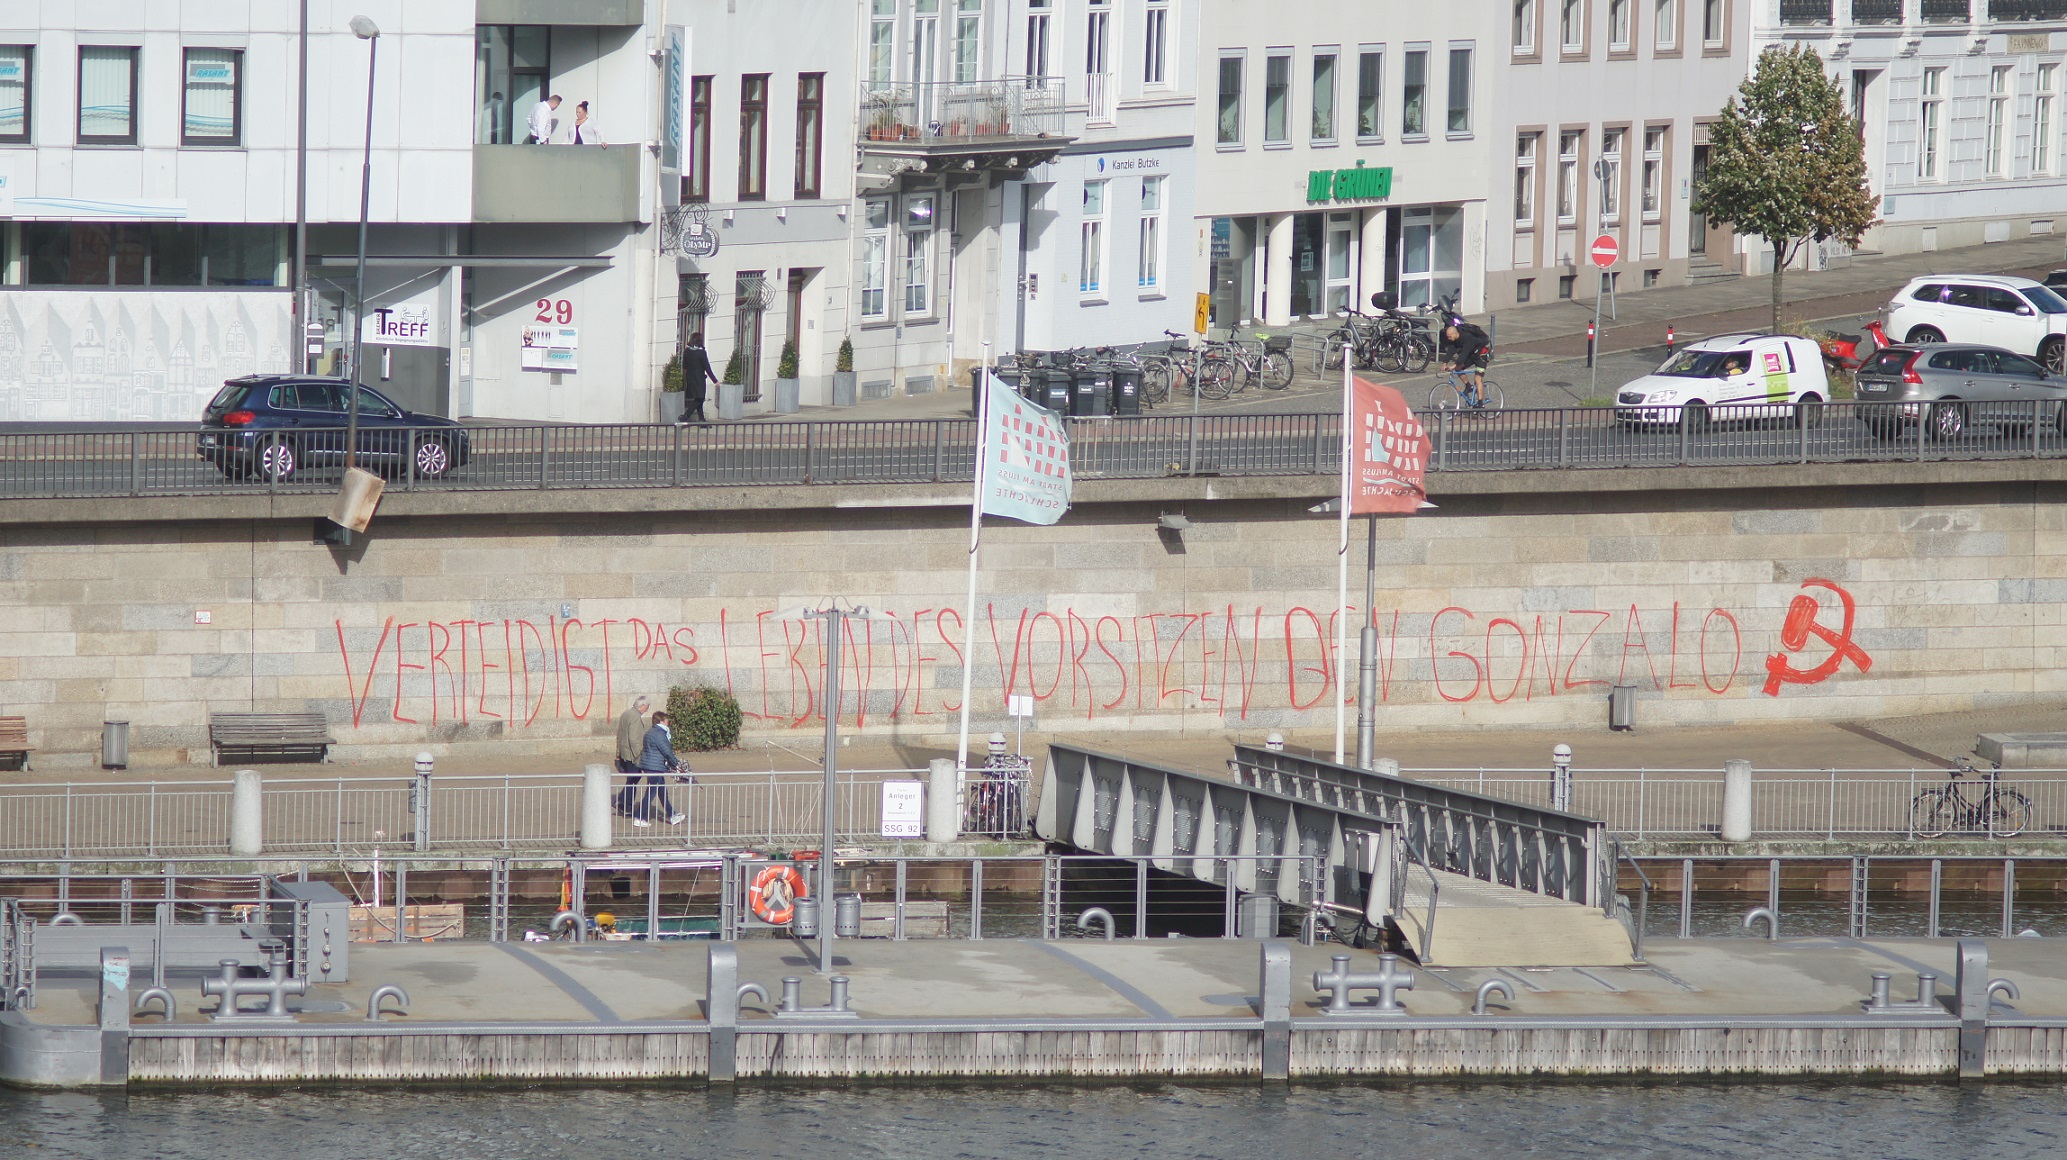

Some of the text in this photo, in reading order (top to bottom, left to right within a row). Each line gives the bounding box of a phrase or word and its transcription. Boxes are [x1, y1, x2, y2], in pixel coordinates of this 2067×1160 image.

[196, 69, 230, 78] RASANT
[671, 31, 681, 147] RASANT
[1112, 158, 1160, 170] Kanzlei Butzke
[1306, 159, 1393, 201] DIE GRÜNEN
[535, 298, 573, 324] 29
[336, 615, 619, 729] VERTEIDIGT
[627, 618, 699, 665] DAS
[720, 607, 872, 729] LEBEN
[886, 607, 967, 718] DES
[1430, 601, 1741, 704] GONZALO
[888, 792, 916, 800] Anleger
[898, 802, 903, 810] 2
[884, 824, 918, 833] SSG 92
